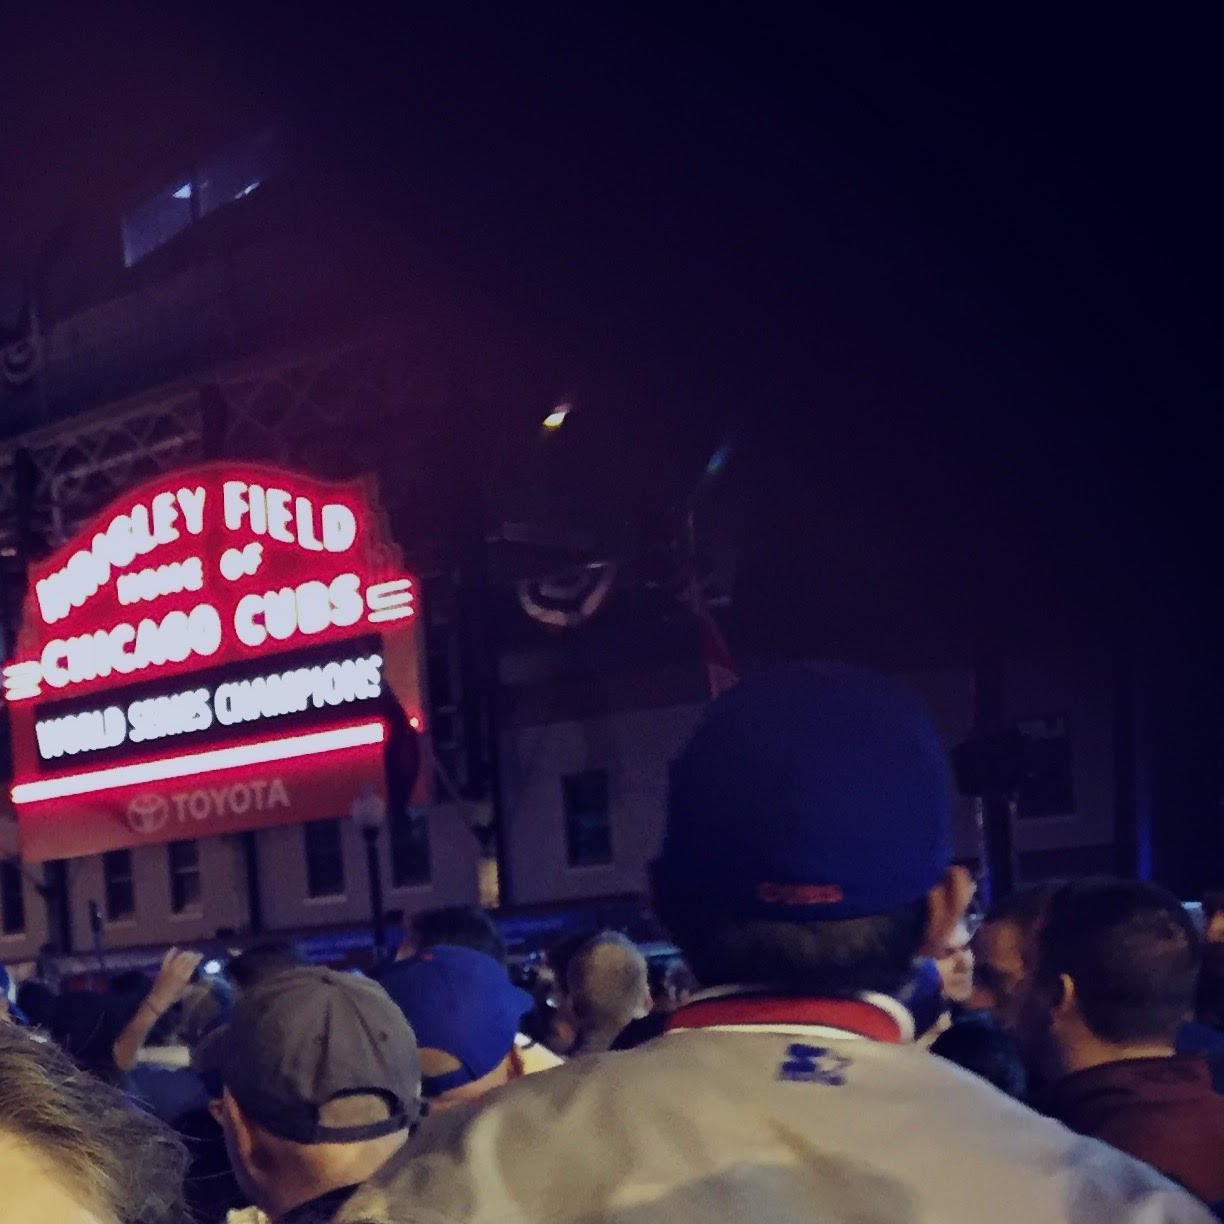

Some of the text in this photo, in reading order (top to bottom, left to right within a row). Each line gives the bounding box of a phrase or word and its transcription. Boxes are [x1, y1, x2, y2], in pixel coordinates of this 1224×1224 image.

[223, 481, 356, 552] FIELD
[220, 542, 263, 581] OF
[40, 573, 364, 688] CHICAGO CUBS
[36, 706, 127, 760] WORLD
[214, 654, 383, 726] CHAMPIONS
[170, 778, 291, 823] TOYOTA
